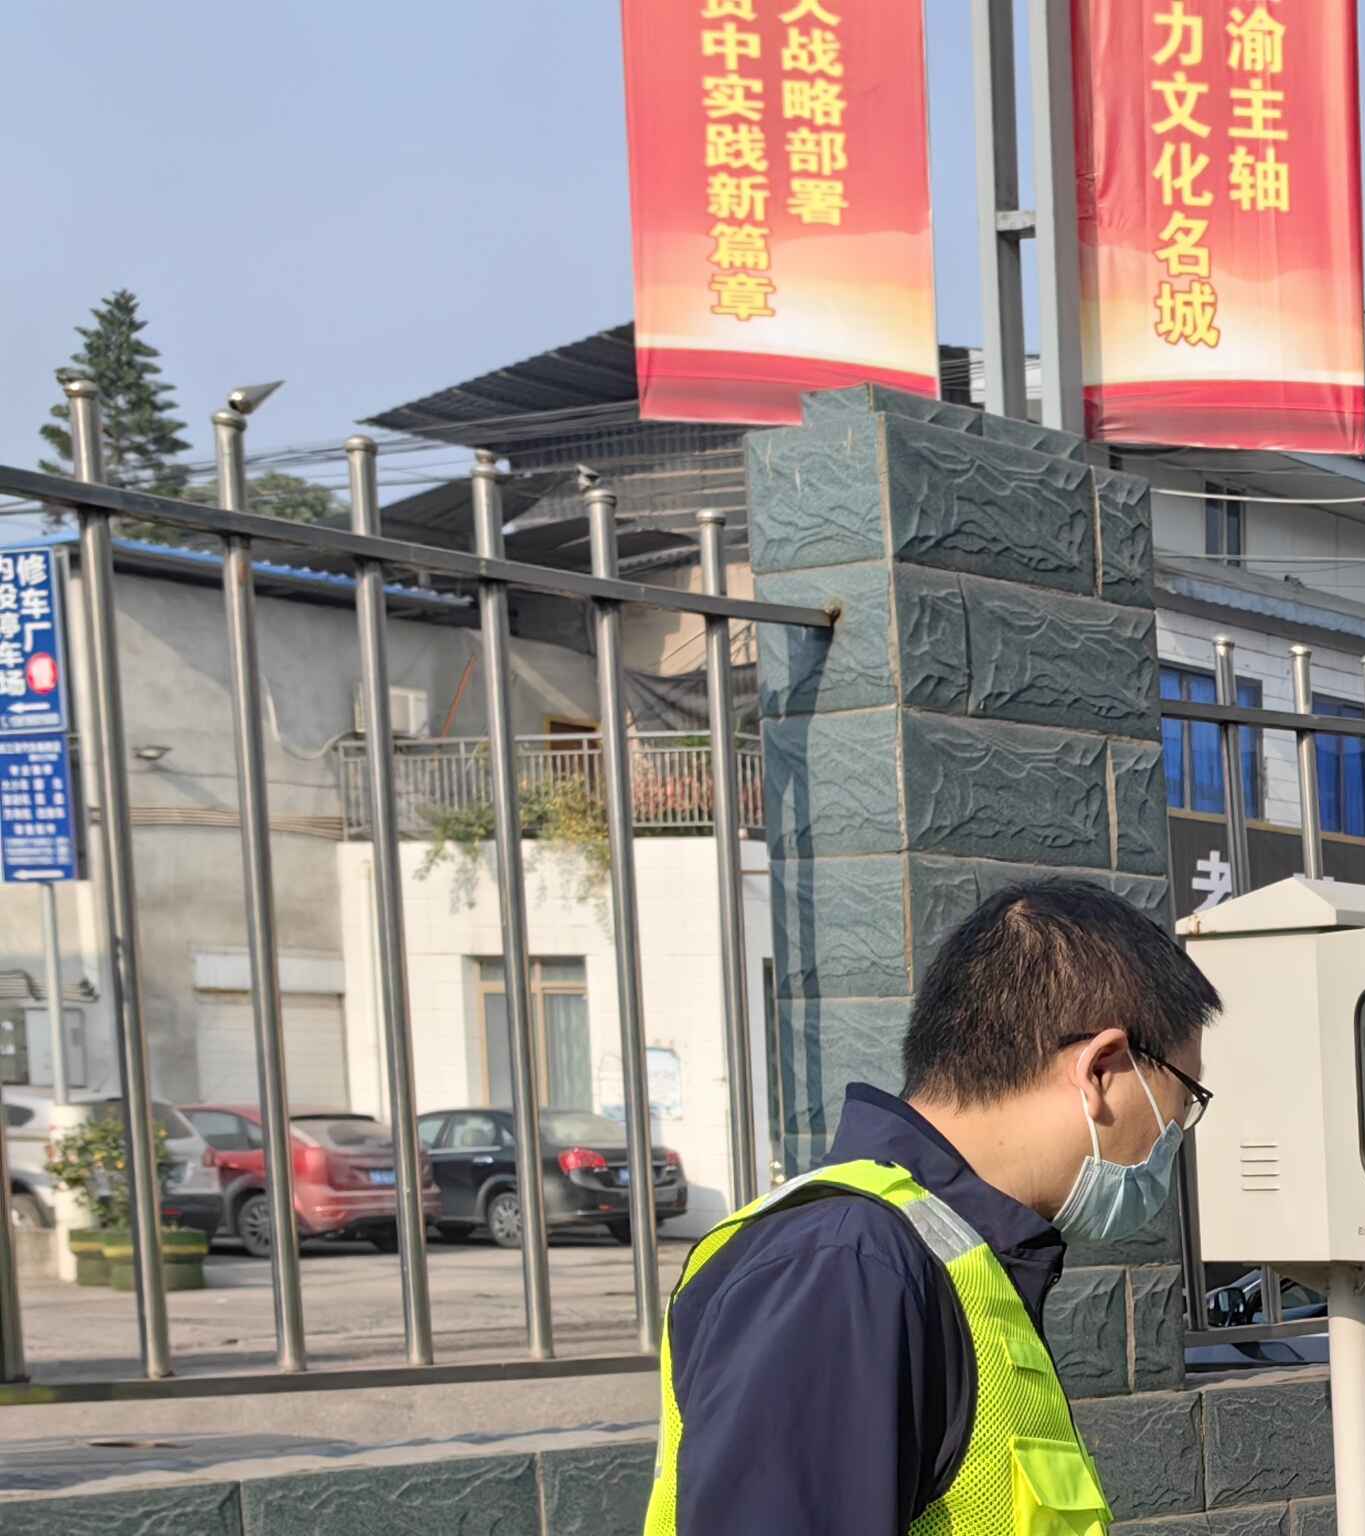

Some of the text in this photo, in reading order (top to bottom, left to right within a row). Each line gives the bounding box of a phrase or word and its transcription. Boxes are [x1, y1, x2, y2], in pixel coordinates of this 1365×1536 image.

[1152, 0, 1220, 348] 力文化名城
[17, 553, 51, 652] 修车厂
